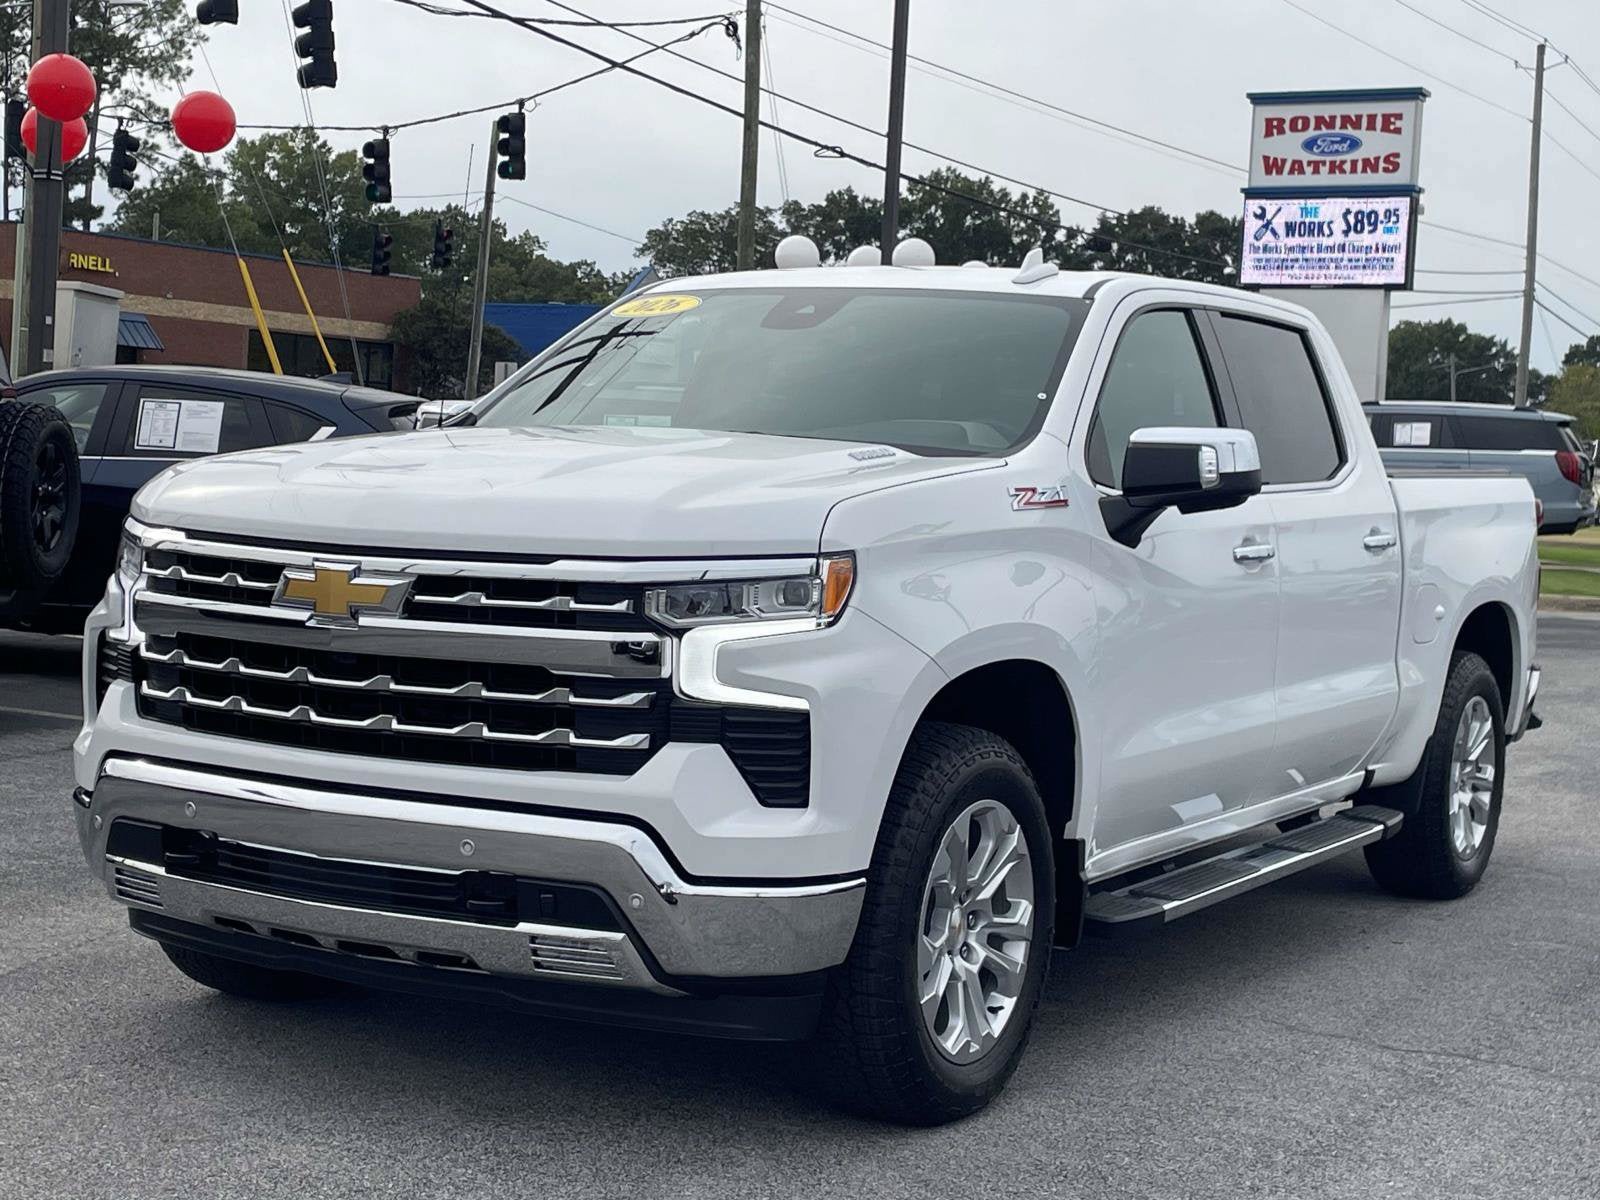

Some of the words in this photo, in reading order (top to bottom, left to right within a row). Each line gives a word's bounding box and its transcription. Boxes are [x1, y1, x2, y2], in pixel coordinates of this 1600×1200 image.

[1263, 113, 1403, 139] RONNIE
[1313, 136, 1351, 153] Ford
[1262, 152, 1401, 176] WATKINS
[1299, 206, 1321, 219] THE
[1284, 220, 1334, 239] WORKS
[1006, 484, 1069, 512] Z71
